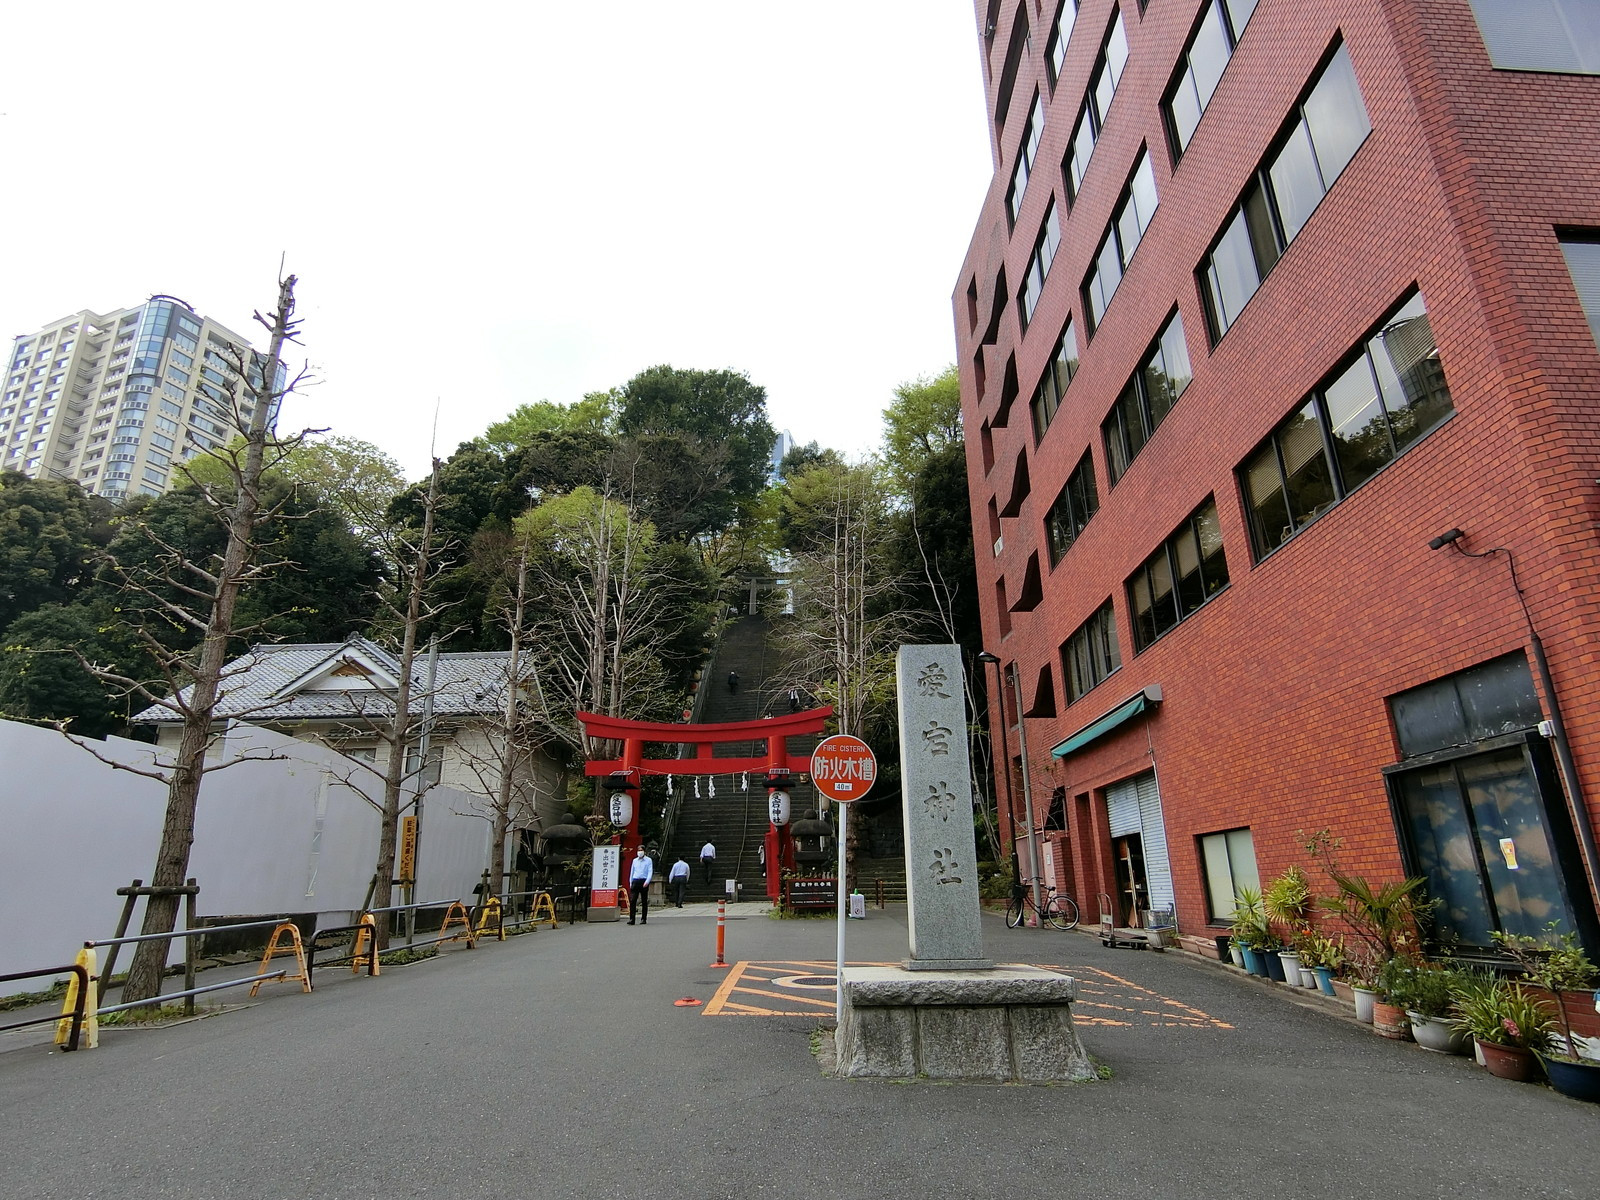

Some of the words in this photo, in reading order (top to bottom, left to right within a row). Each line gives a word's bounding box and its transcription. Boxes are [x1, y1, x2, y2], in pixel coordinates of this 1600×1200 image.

[823, 744, 837, 752] FIRE
[839, 745, 866, 753] CISTERN
[916, 661, 963, 886] 愛宕神社
